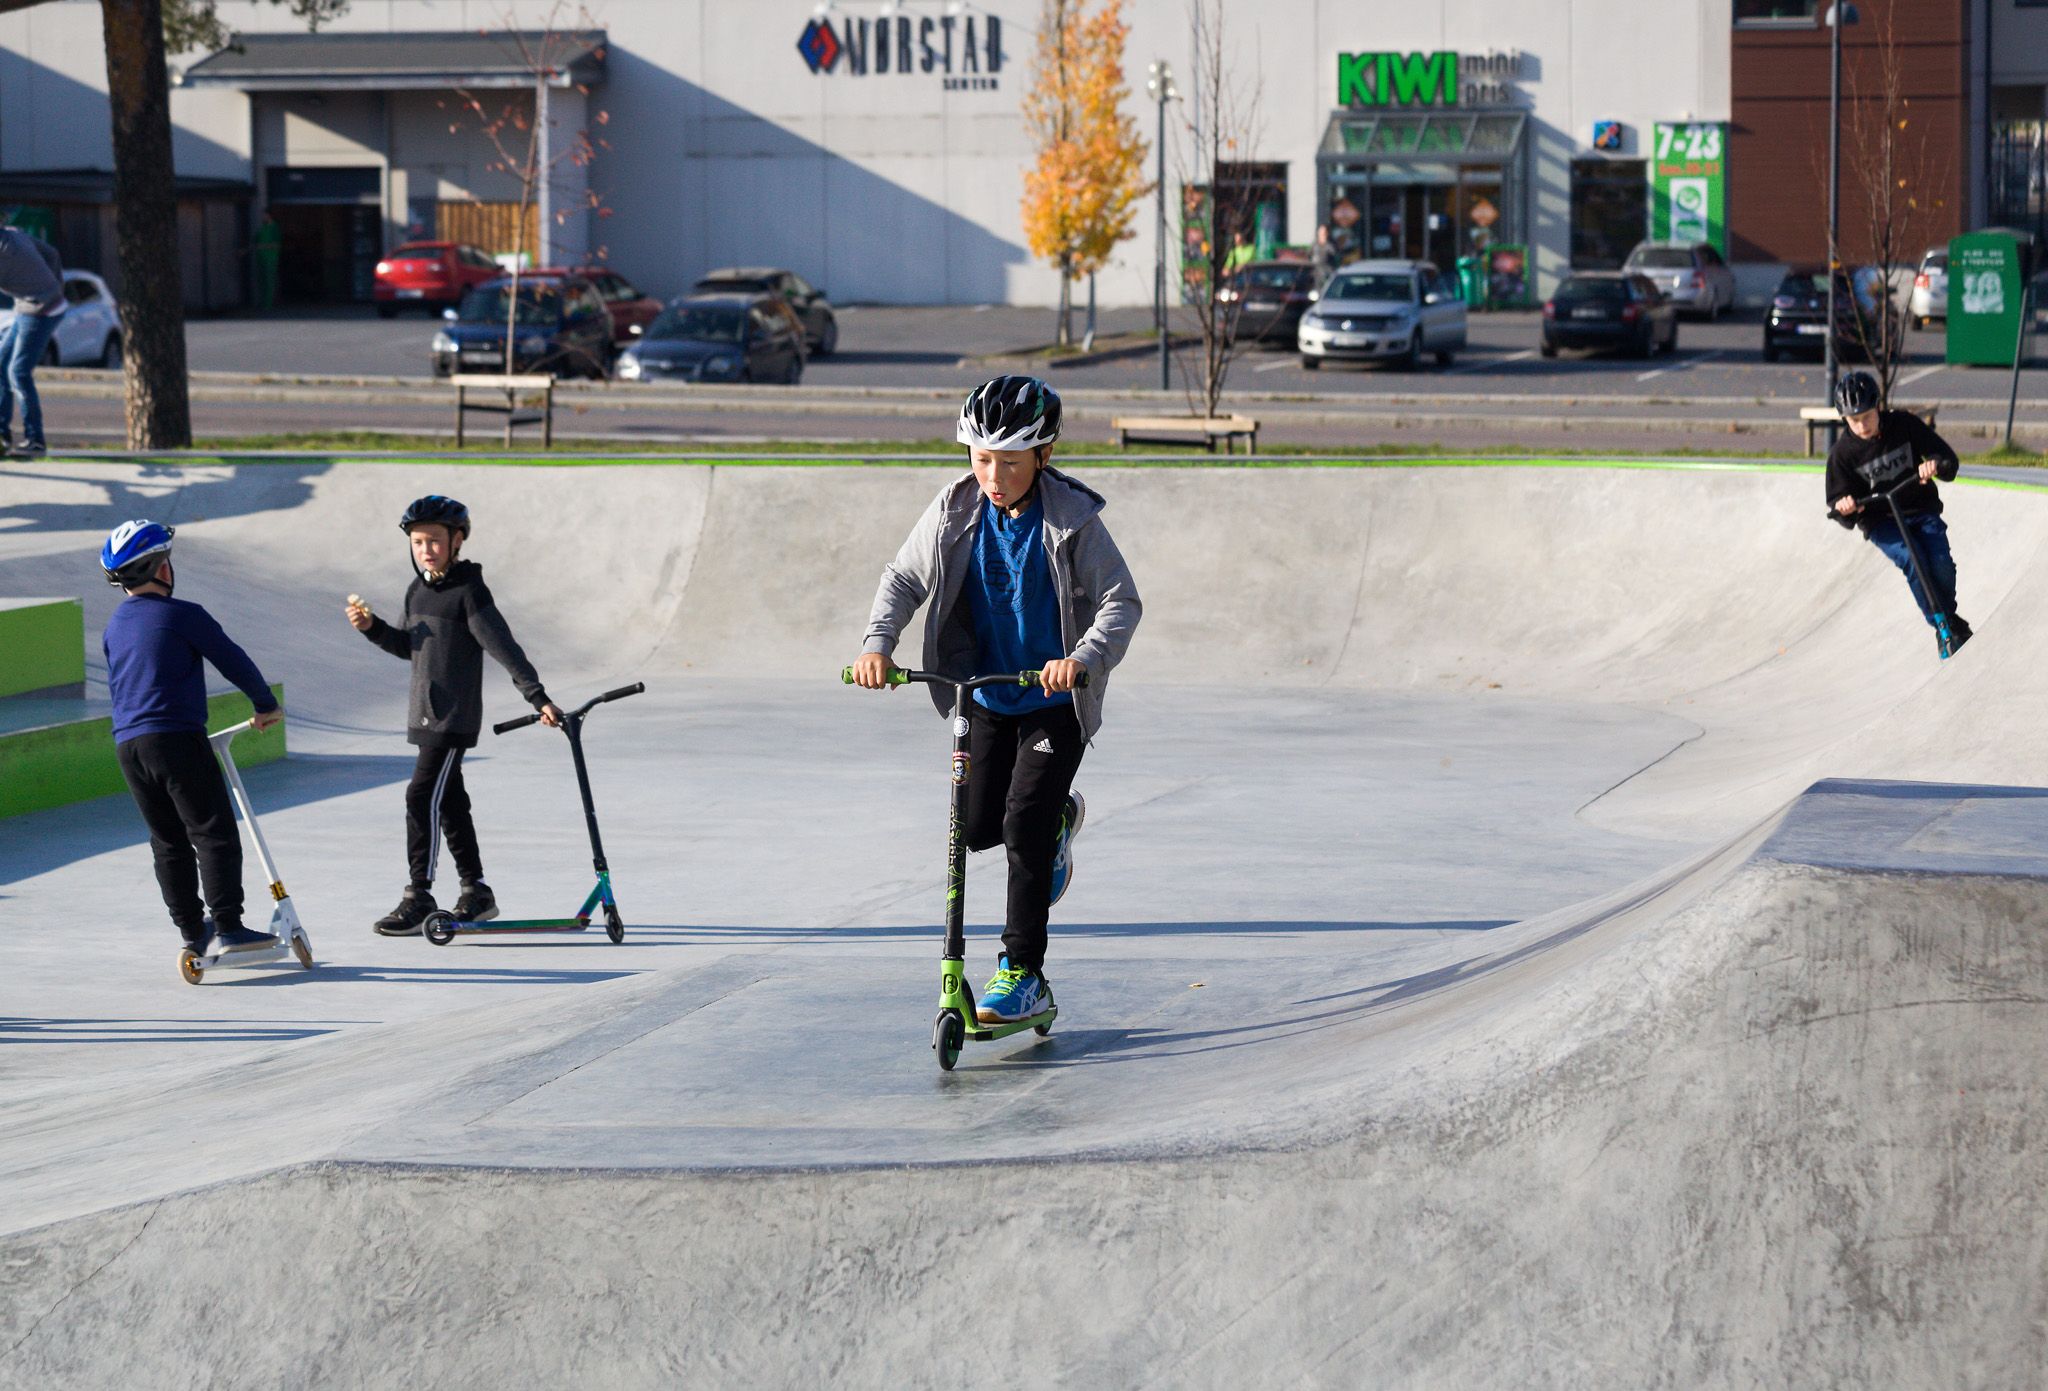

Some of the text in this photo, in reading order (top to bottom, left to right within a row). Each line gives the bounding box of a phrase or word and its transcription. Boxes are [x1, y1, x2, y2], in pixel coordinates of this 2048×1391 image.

[1465, 47, 1521, 75] mini
[1337, 50, 1459, 106] KIWI
[1465, 81, 1511, 107] pris
[1657, 125, 1721, 160] 7-23
[1033, 745, 1054, 754] adidas
